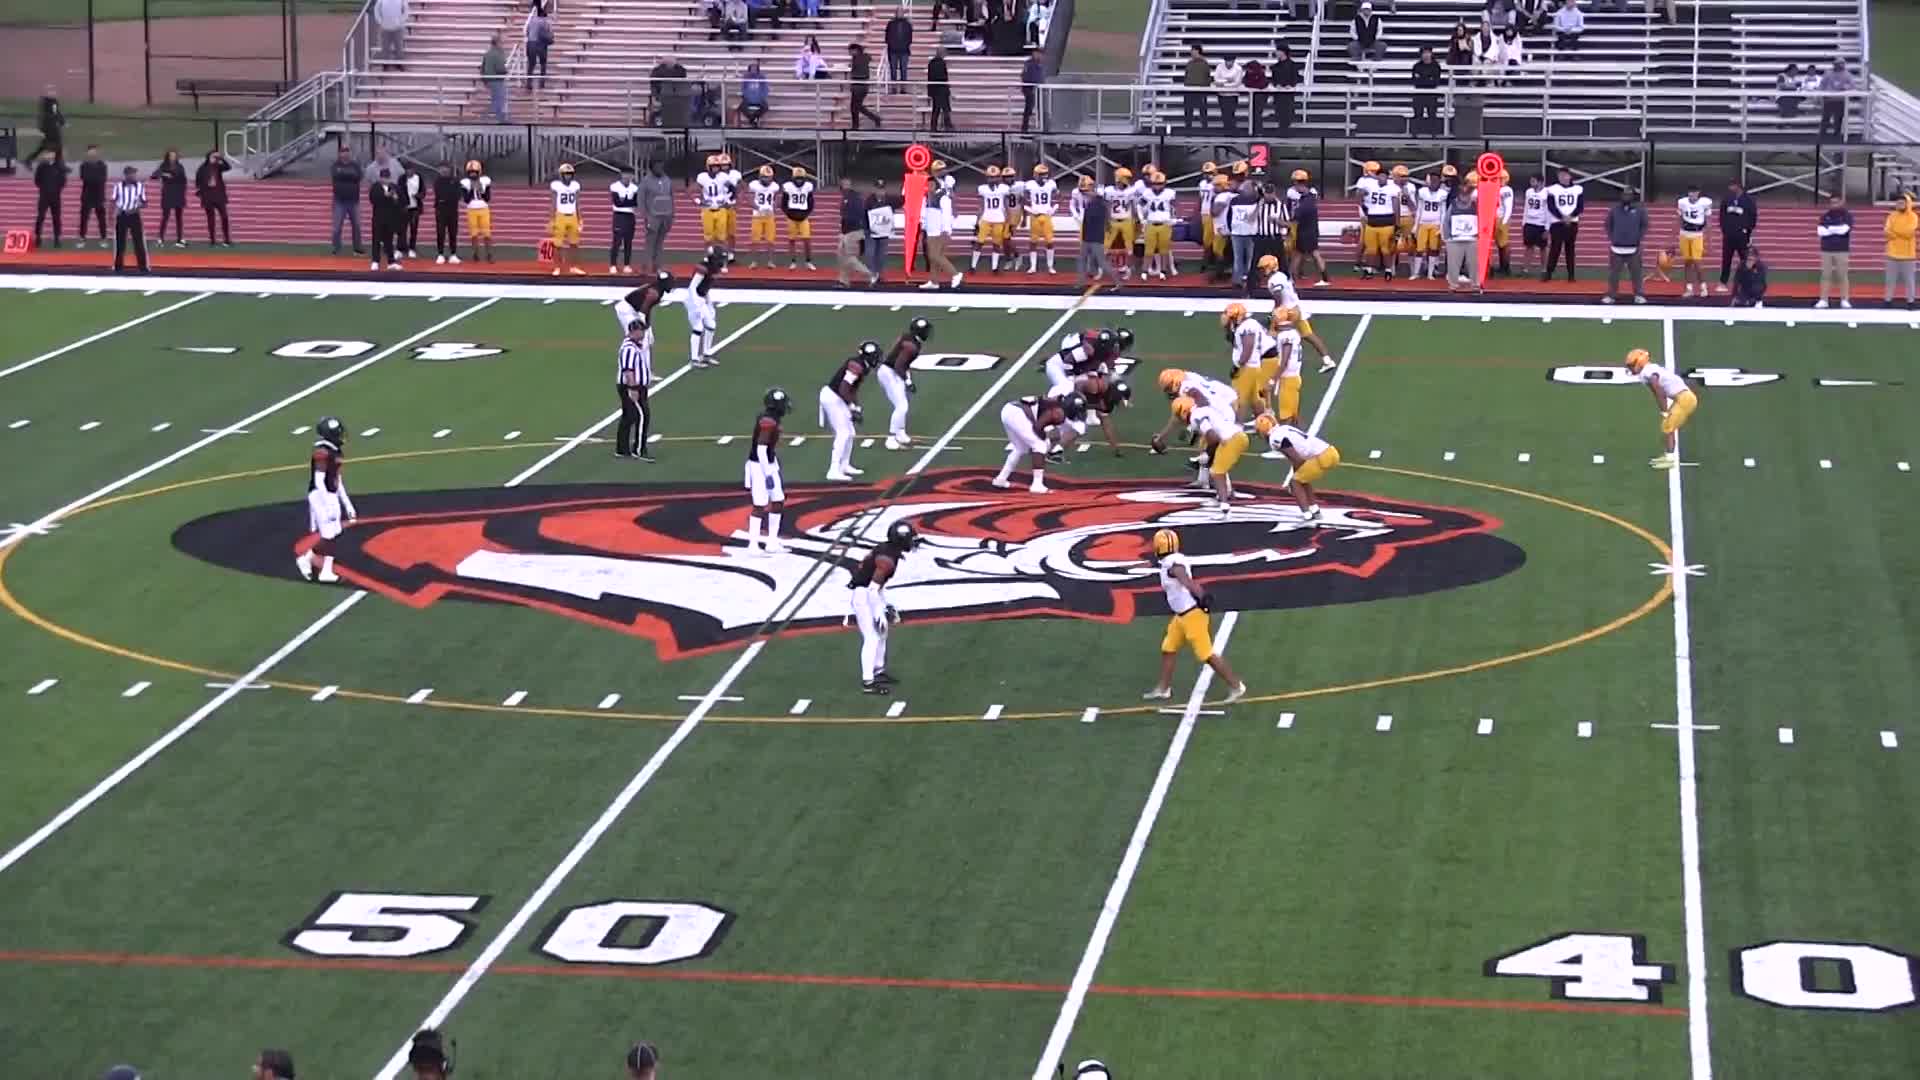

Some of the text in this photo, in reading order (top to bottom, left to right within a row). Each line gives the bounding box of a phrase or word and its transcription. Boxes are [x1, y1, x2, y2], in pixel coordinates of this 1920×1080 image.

[1250, 144, 1268, 167] 2
[560, 193, 575, 204] 20
[757, 192, 772, 206] 34
[987, 197, 999, 209] 10
[1035, 192, 1048, 205] 19
[1371, 191, 1386, 206] 55
[1558, 194, 1574, 206] 60
[7, 233, 27, 249] 30
[292, 892, 727, 965] 50
[1493, 931, 1917, 1011] 40
